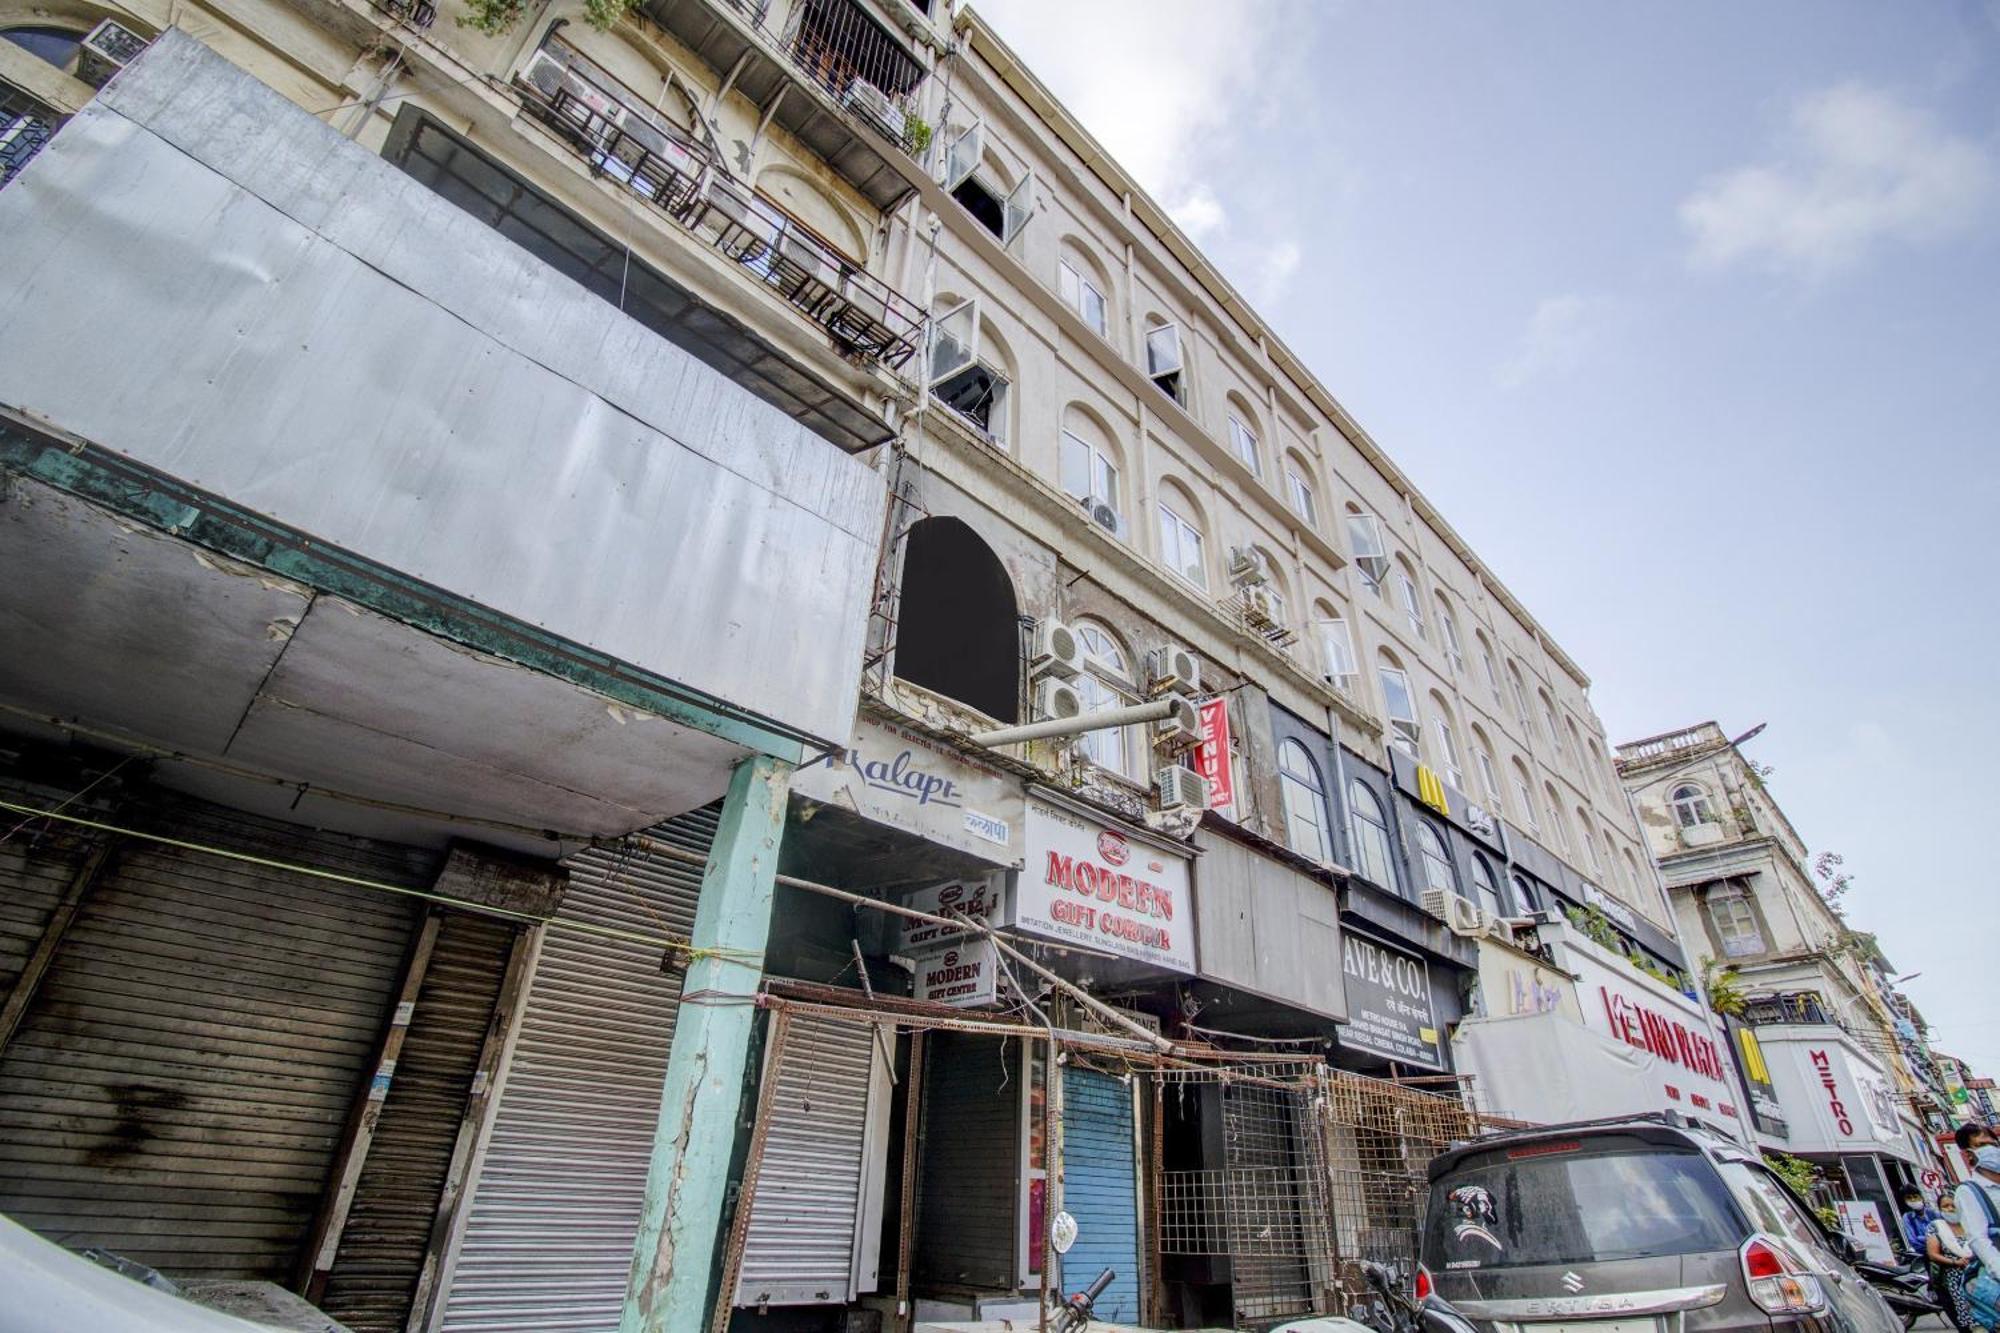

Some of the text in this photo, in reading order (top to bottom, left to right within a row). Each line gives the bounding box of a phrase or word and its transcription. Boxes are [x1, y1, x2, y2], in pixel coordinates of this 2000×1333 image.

[1201, 706, 1218, 792] VENUS
[1051, 899, 1097, 949] GIFT
[926, 962, 981, 987] MODERN
[1809, 1049, 1853, 1136] METRO
